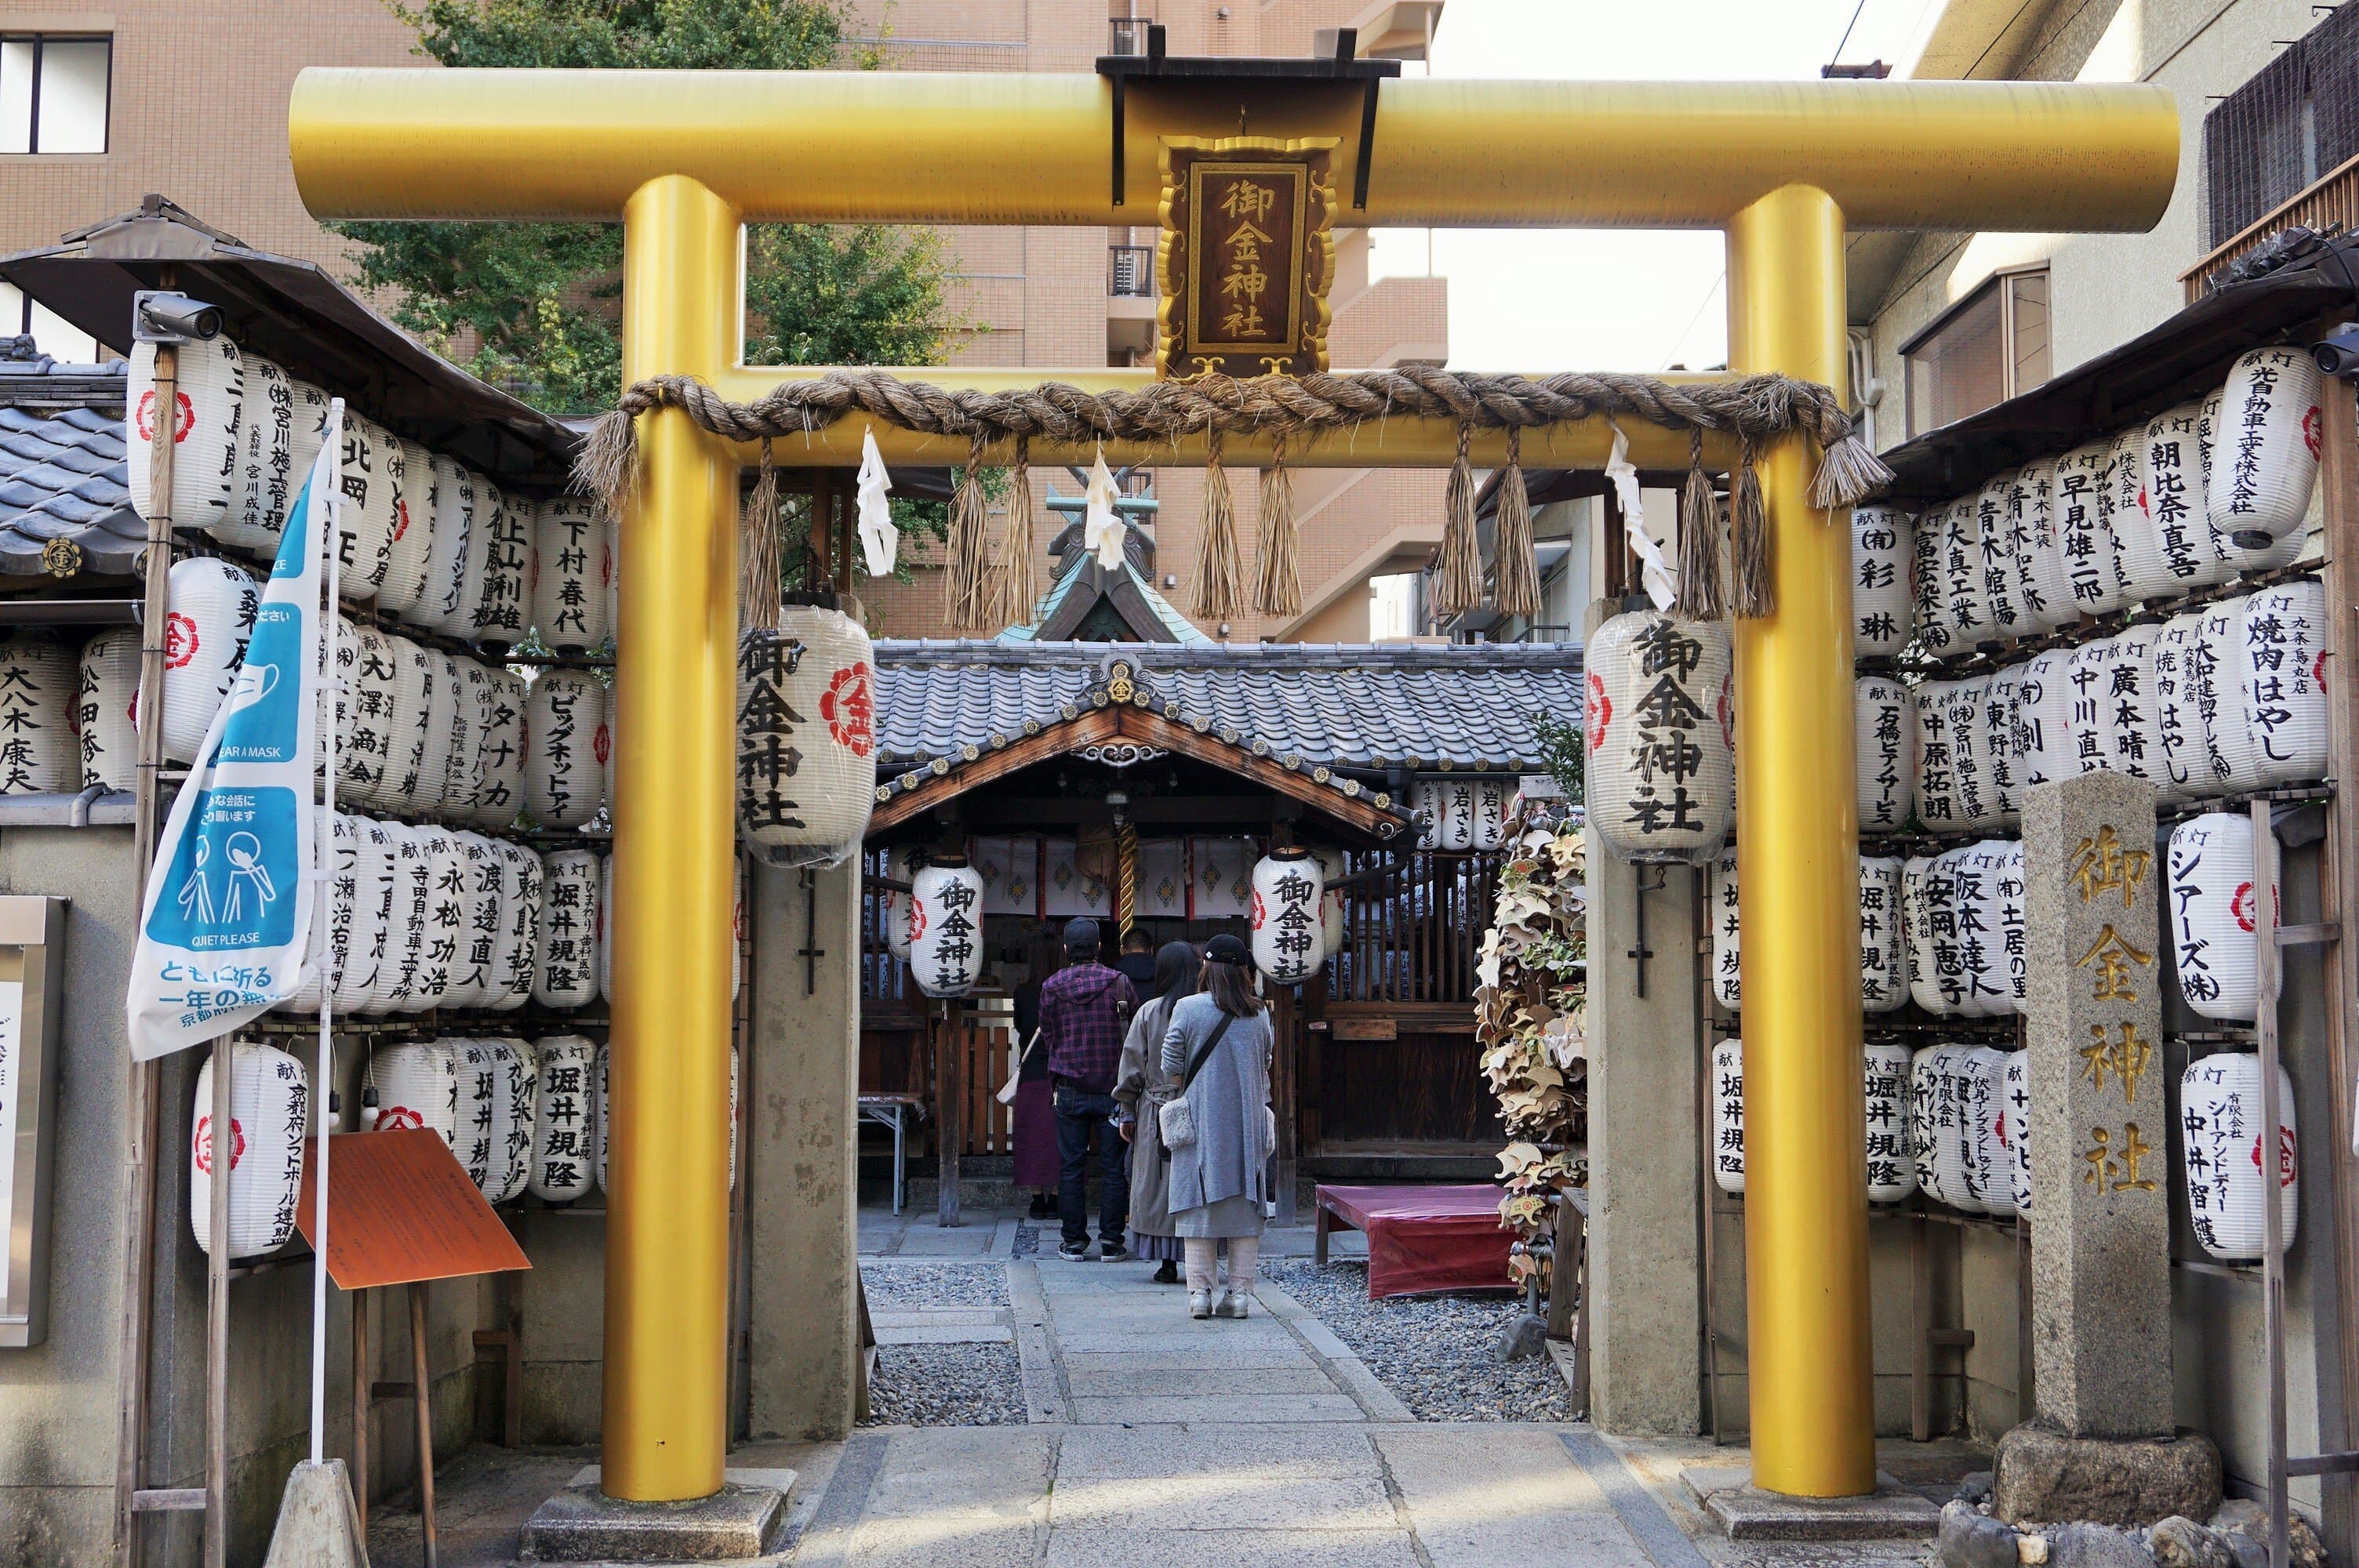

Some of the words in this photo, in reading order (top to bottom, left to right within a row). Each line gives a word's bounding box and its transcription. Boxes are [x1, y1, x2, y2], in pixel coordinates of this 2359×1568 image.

[1221, 180, 1275, 337] 御金神社
[2241, 350, 2295, 368] 献灯
[242, 463, 263, 525] 宮川成佳
[2118, 451, 2138, 510] 株式会社
[2227, 367, 2279, 515] 光自動車工業株式会社
[1856, 513, 1896, 527] 献灯
[2032, 479, 2053, 549] 青木建装
[2059, 474, 2104, 604] 早見雄二郎
[2150, 441, 2201, 579] 朝比奈真吾
[495, 516, 527, 630] 上山利雄
[554, 521, 588, 633] 下村春代
[1944, 521, 1985, 630] 大真工業
[2246, 612, 2299, 761] 焼肉はやし
[2288, 615, 2311, 695] 九条烏丸店
[240, 747, 248, 757] A
[249, 746, 282, 757] MASK
[483, 702, 516, 808] タナカ
[543, 695, 578, 819] ビッグネットアイ
[737, 626, 809, 832] 御金神社
[1623, 618, 1714, 835] 御金神社
[1870, 706, 1903, 825] 石橋ピアノサービス
[1921, 713, 1953, 820] 中原拓朗
[1986, 700, 2019, 812] 東野達生
[2156, 650, 2189, 784] 焼肉はやし
[447, 756, 465, 798] 西谷一正
[1451, 786, 1471, 844] 岩さき
[1481, 790, 1499, 844] 岩さき
[191, 935, 219, 947] QUIET
[220, 931, 260, 946] PLEASE
[388, 864, 430, 1004] 寺田自動車工業所
[419, 861, 465, 996] 永松功浩
[456, 862, 503, 989] 渡邊直人
[545, 881, 581, 993] 堀井規隆
[576, 879, 596, 981] ひまわり歯科医院
[931, 875, 976, 989] 御金神社
[1270, 866, 1316, 979] 御金神社
[1886, 884, 1901, 988] ひまわり歯科医院
[1912, 887, 1931, 939] 株式会社
[1925, 874, 1968, 1006] 安岡恵子
[1956, 870, 2005, 999] 阪本達人
[2172, 851, 2220, 1002] シアーズ(株)
[160, 960, 273, 990] ともに祈る
[2067, 823, 2157, 1196] 御金神社
[543, 1065, 583, 1189] 堀井規隆
[578, 1062, 594, 1161] ひまわり歯科医院
[1866, 1075, 1905, 1187] 堀井規隆
[1937, 1070, 1957, 1128] 有限会社
[1972, 1076, 1992, 1190] 伏見インプラントセンター
[2226, 1091, 2245, 1139] 有限会社
[263, 1083, 308, 1247] 京都府ソフトボール連盟
[2184, 1106, 2228, 1249] 中井智護
[2207, 1100, 2230, 1213] シーアンドディー
